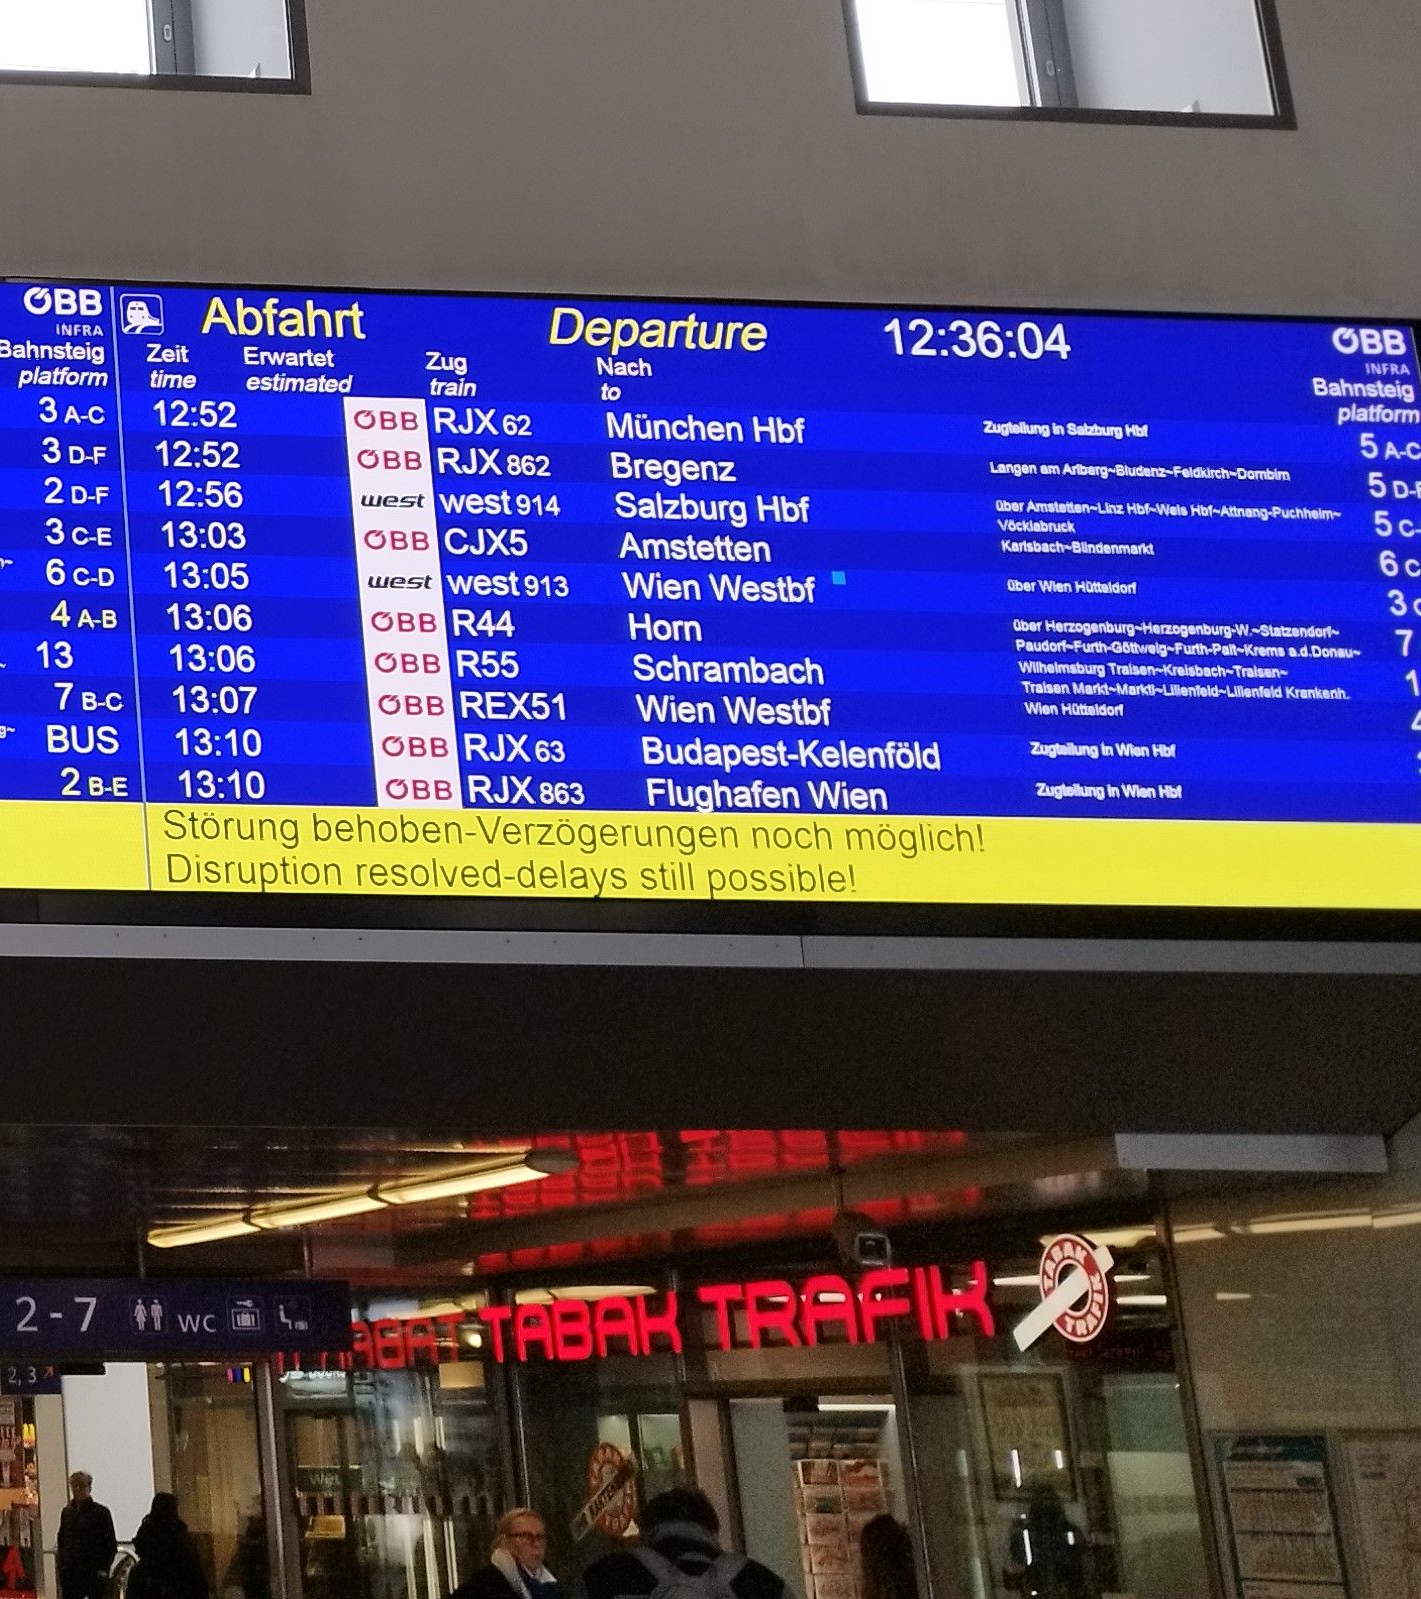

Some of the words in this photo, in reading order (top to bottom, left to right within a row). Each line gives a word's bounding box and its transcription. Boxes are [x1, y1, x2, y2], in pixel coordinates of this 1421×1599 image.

[57, 324, 103, 336] INFRA
[202, 297, 366, 339] Abfahrt
[550, 308, 767, 355] Departure
[884, 318, 1071, 359] 12:36:04
[18, 366, 108, 388] platform
[147, 344, 189, 362] Zeit
[244, 347, 334, 367] Erwartet
[425, 352, 467, 375] Zug
[597, 357, 652, 376] Nach
[1313, 378, 1414, 402] Bahnsteig
[1366, 363, 1410, 374] INFRA
[39, 397, 57, 422] 3
[64, 406, 105, 424] A-C
[151, 370, 196, 388] time
[246, 373, 353, 392] estimated
[430, 378, 476, 396] train
[601, 383, 621, 400] to
[1338, 404, 1420, 425] platform
[154, 400, 237, 427] 12:52
[434, 407, 499, 435] RJX
[503, 415, 532, 435] 62
[607, 412, 743, 442] München
[753, 416, 805, 443] Hbf
[1125, 424, 1148, 437] Hbf
[1361, 433, 1378, 458] 5
[1385, 442, 1421, 459] A-C
[45, 477, 62, 503] 2
[71, 486, 109, 504] D-F
[159, 480, 242, 507] 12:56
[361, 495, 424, 507] west
[439, 490, 512, 515] west
[516, 494, 560, 516] 914
[616, 491, 747, 527] Salzburg
[756, 495, 809, 522] Hbf
[997, 519, 1075, 533] Vöcklabruck
[1375, 511, 1392, 536] 5
[46, 559, 65, 585] 6
[73, 568, 114, 586] C-D
[620, 532, 771, 562] Amstetten
[1380, 550, 1398, 576] 6
[51, 600, 70, 627] 4
[78, 609, 117, 628] A-B
[37, 641, 73, 668] 13
[456, 650, 519, 678] R55
[633, 654, 824, 685] Schrambach
[54, 683, 73, 710] 7
[82, 692, 124, 711] B-C
[47, 725, 119, 754] BUS
[176, 728, 261, 756] 13:10
[464, 733, 531, 762] RJX
[536, 740, 565, 762] 63
[642, 736, 940, 773] Budapest-Kelenföld
[61, 767, 81, 795] 2
[89, 777, 128, 796] B-E
[164, 810, 298, 848] Störung
[313, 810, 744, 850] behoben-Verzögerungen
[752, 822, 832, 849] noch
[846, 824, 984, 858] möglich!
[166, 855, 342, 892] Disruption
[353, 858, 627, 898] resolved-delays
[641, 862, 694, 890] still
[708, 864, 855, 899] possible!
[1043, 1240, 1087, 1292] TABAK
[481, 1290, 683, 1363] TABAK
[697, 1261, 996, 1350] TRAFIK
[1065, 1274, 1104, 1336] TRAFIK
